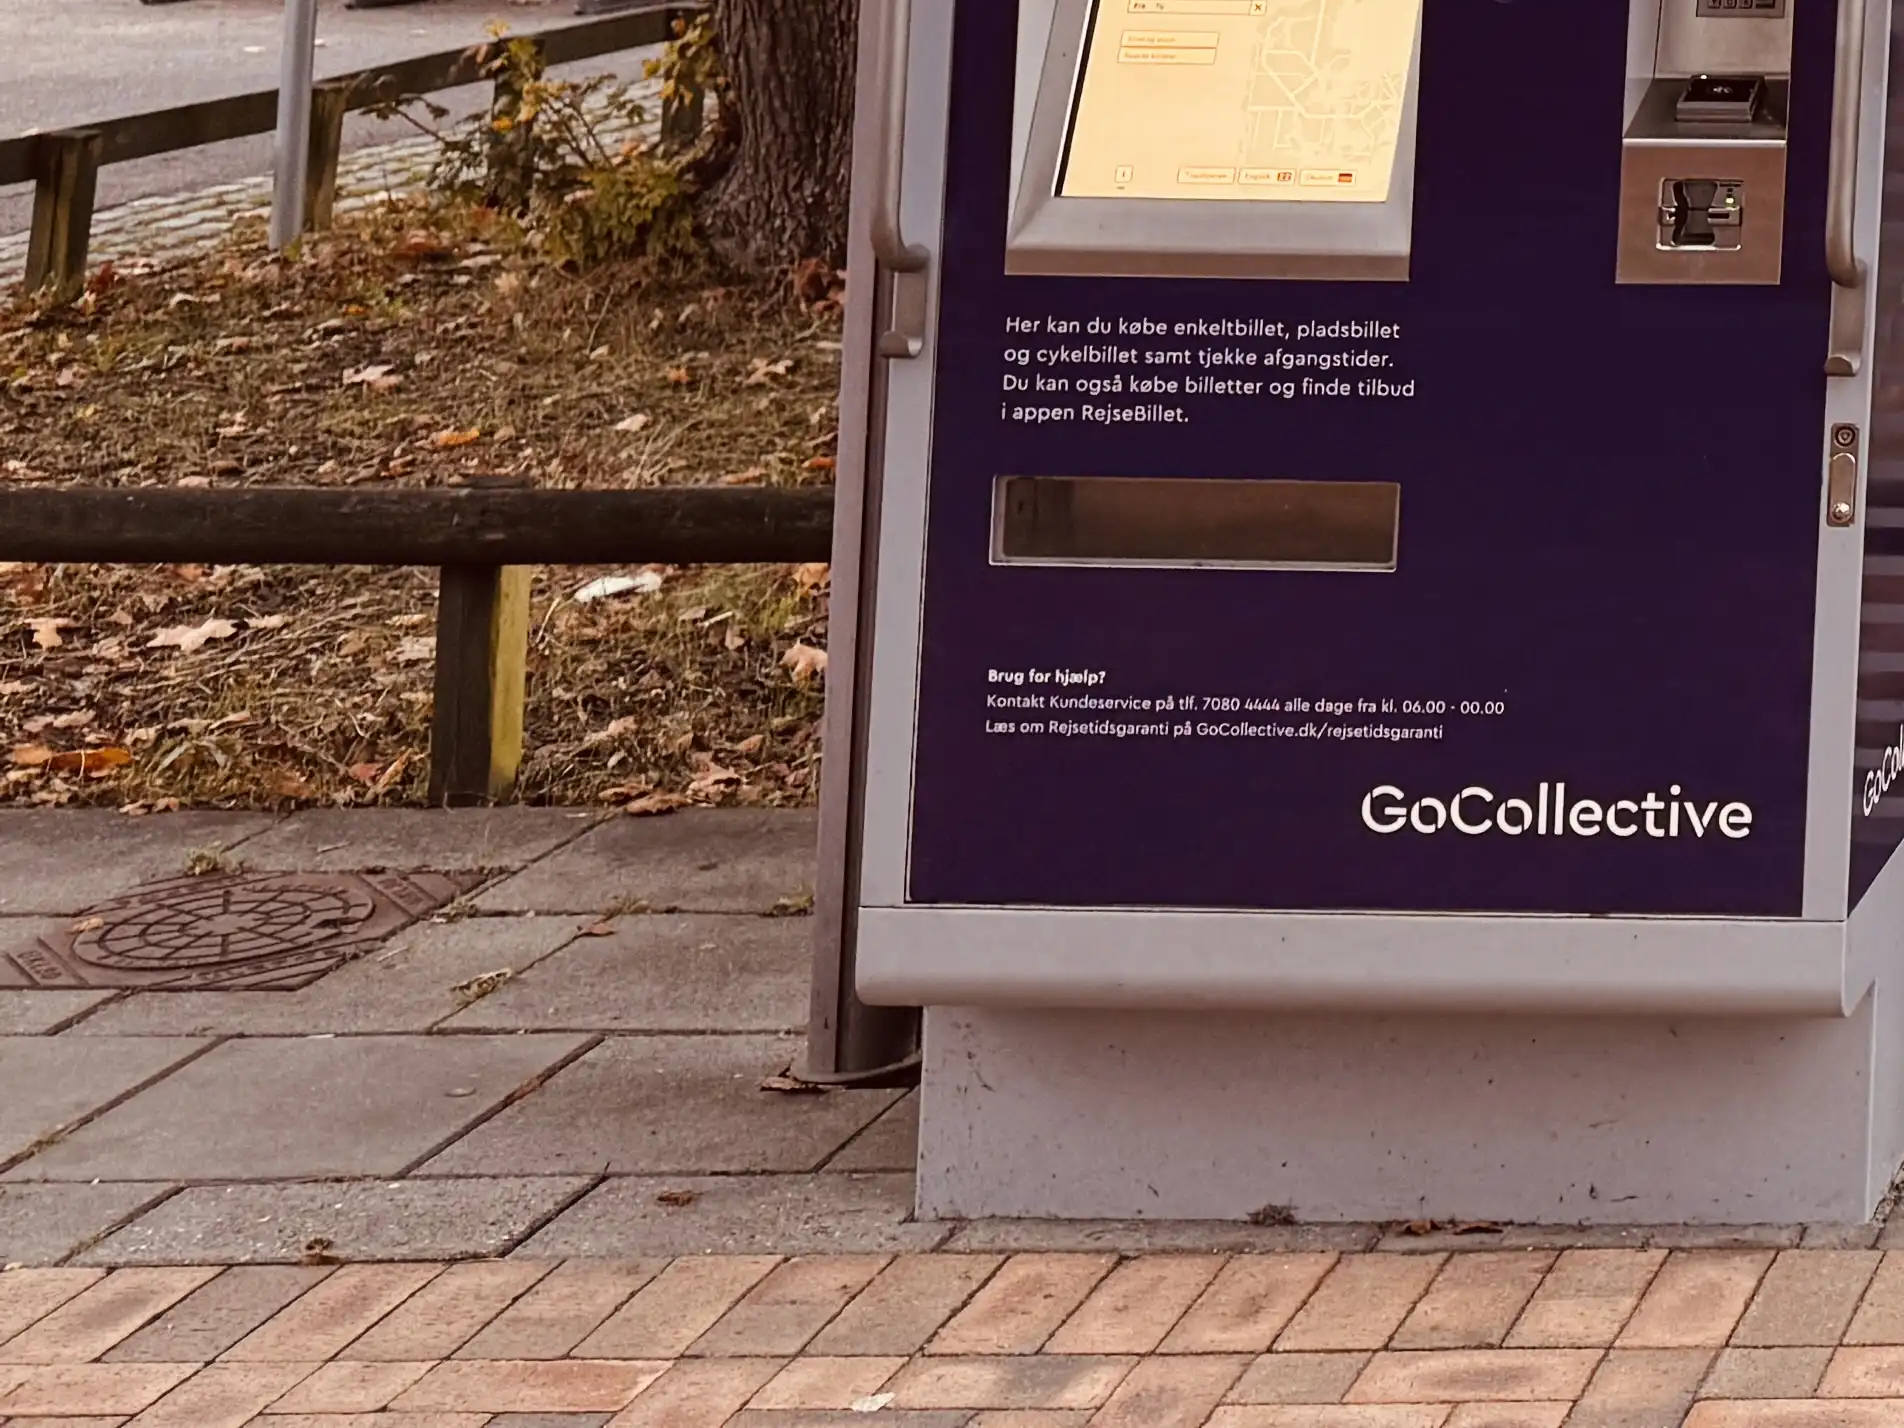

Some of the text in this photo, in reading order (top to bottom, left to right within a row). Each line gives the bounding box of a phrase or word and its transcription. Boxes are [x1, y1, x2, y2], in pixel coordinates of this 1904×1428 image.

[1007, 316, 1399, 340] Her kan du købe enkeltbillet, pladsbillet
[1004, 345, 1393, 370] og cykelbillet samt tjekke afgangstider.
[1004, 374, 1414, 398] Du kan også købe billetter og finde tilbud
[1002, 403, 1188, 424] i appen RejseBillet.
[989, 669, 1105, 686] Brug for hjælp?
[987, 694, 1045, 708] Kontakt
[1050, 695, 1151, 709] Kundeservice
[1156, 696, 1174, 711] på
[1179, 696, 1197, 710] tlf.
[1203, 697, 1240, 710] 7080
[1245, 699, 1279, 710] 4444
[1285, 698, 1310, 711] alle
[1315, 698, 1353, 715] dage
[1358, 698, 1376, 712] fra
[1403, 701, 1445, 713] 06.00
[1461, 701, 1504, 714] 00.00
[986, 720, 1442, 741] Læs om Rejsetidsgaranti på GoCollective.dk/rejsetidsgaranti
[1362, 782, 1752, 838] GoCollective
